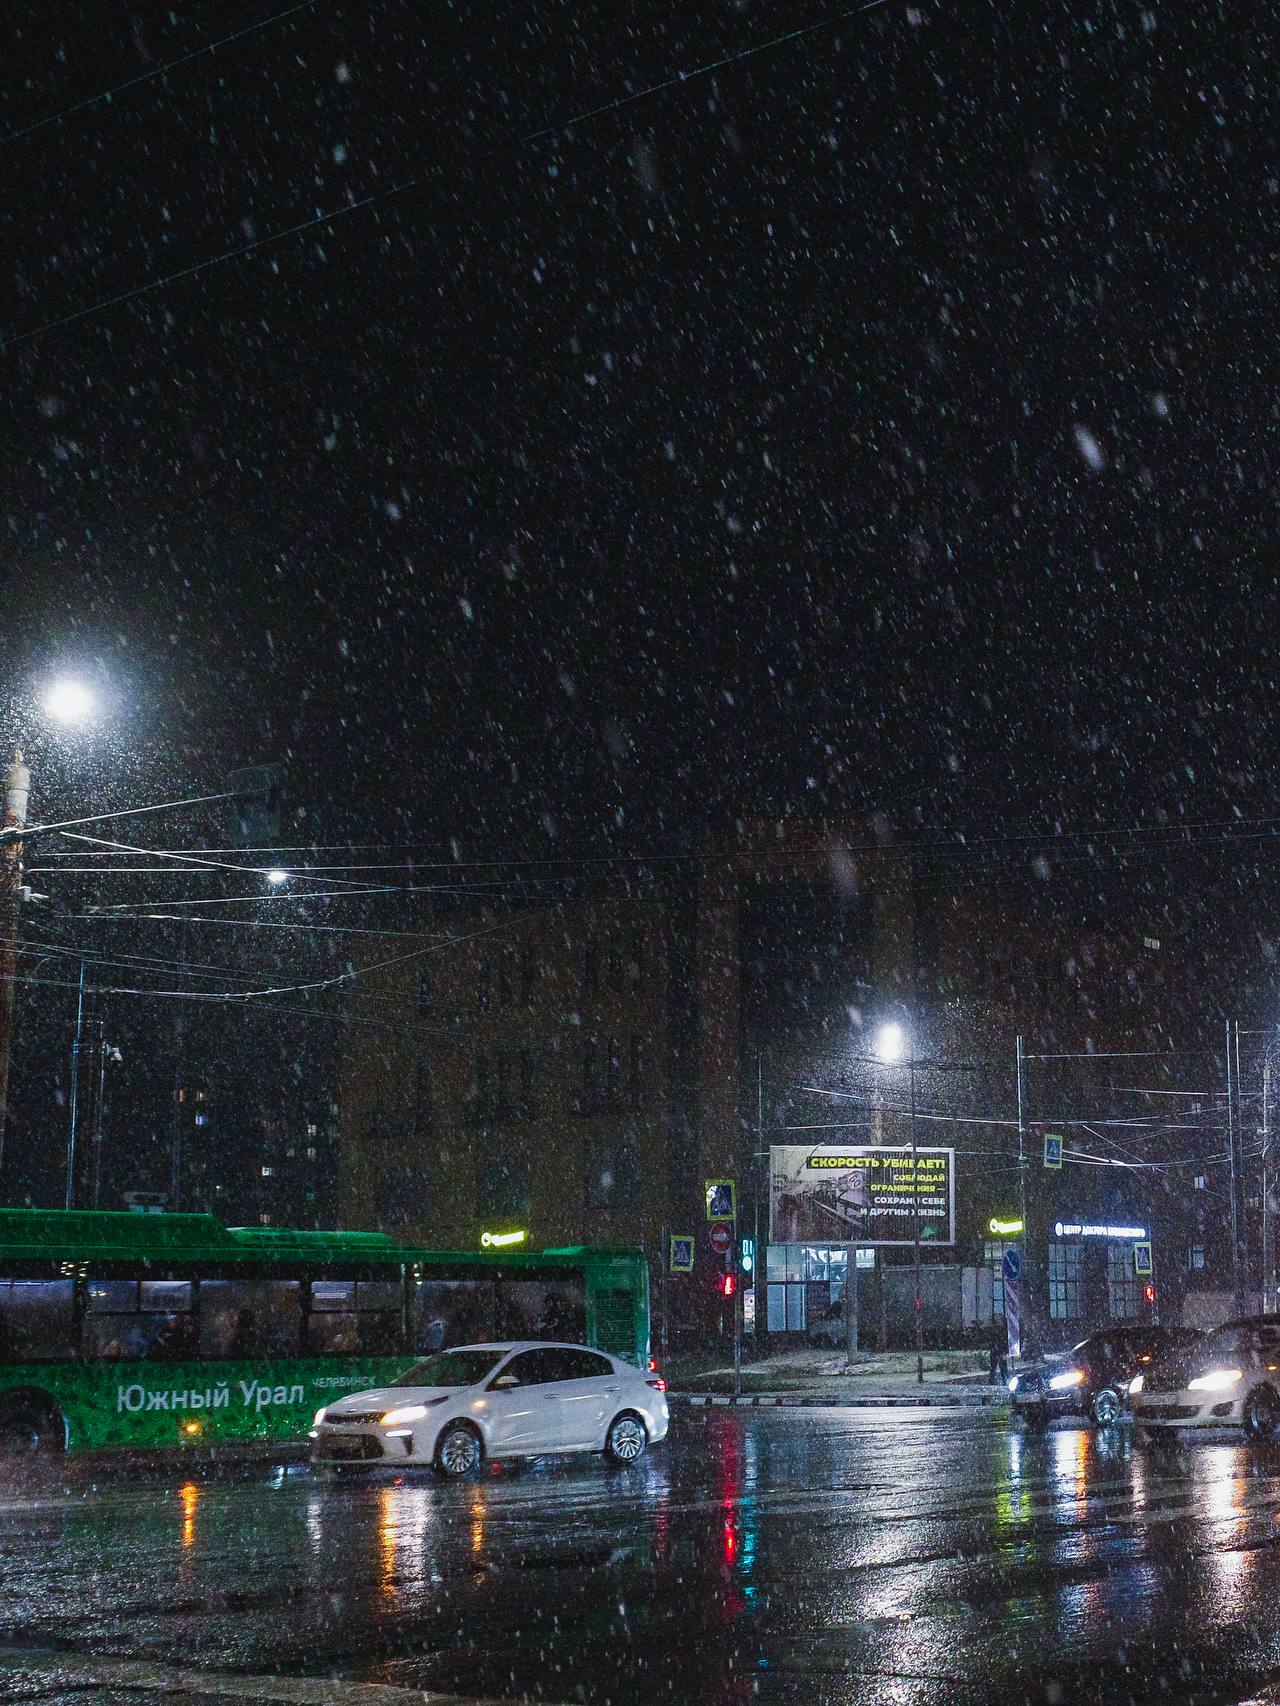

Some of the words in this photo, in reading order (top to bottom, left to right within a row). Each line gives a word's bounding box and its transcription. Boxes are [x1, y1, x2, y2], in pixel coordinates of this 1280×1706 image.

[811, 1157, 880, 1169] СКОРОСТЬ
[922, 1197, 946, 1205] СЕБЕ
[860, 1208, 868, 1216] И
[870, 1208, 909, 1217] ДРУГИМ
[312, 1375, 376, 1388] ЧЕЛЯБИНСК
[117, 1381, 230, 1412] Южный
[239, 1379, 305, 1412] Урал
